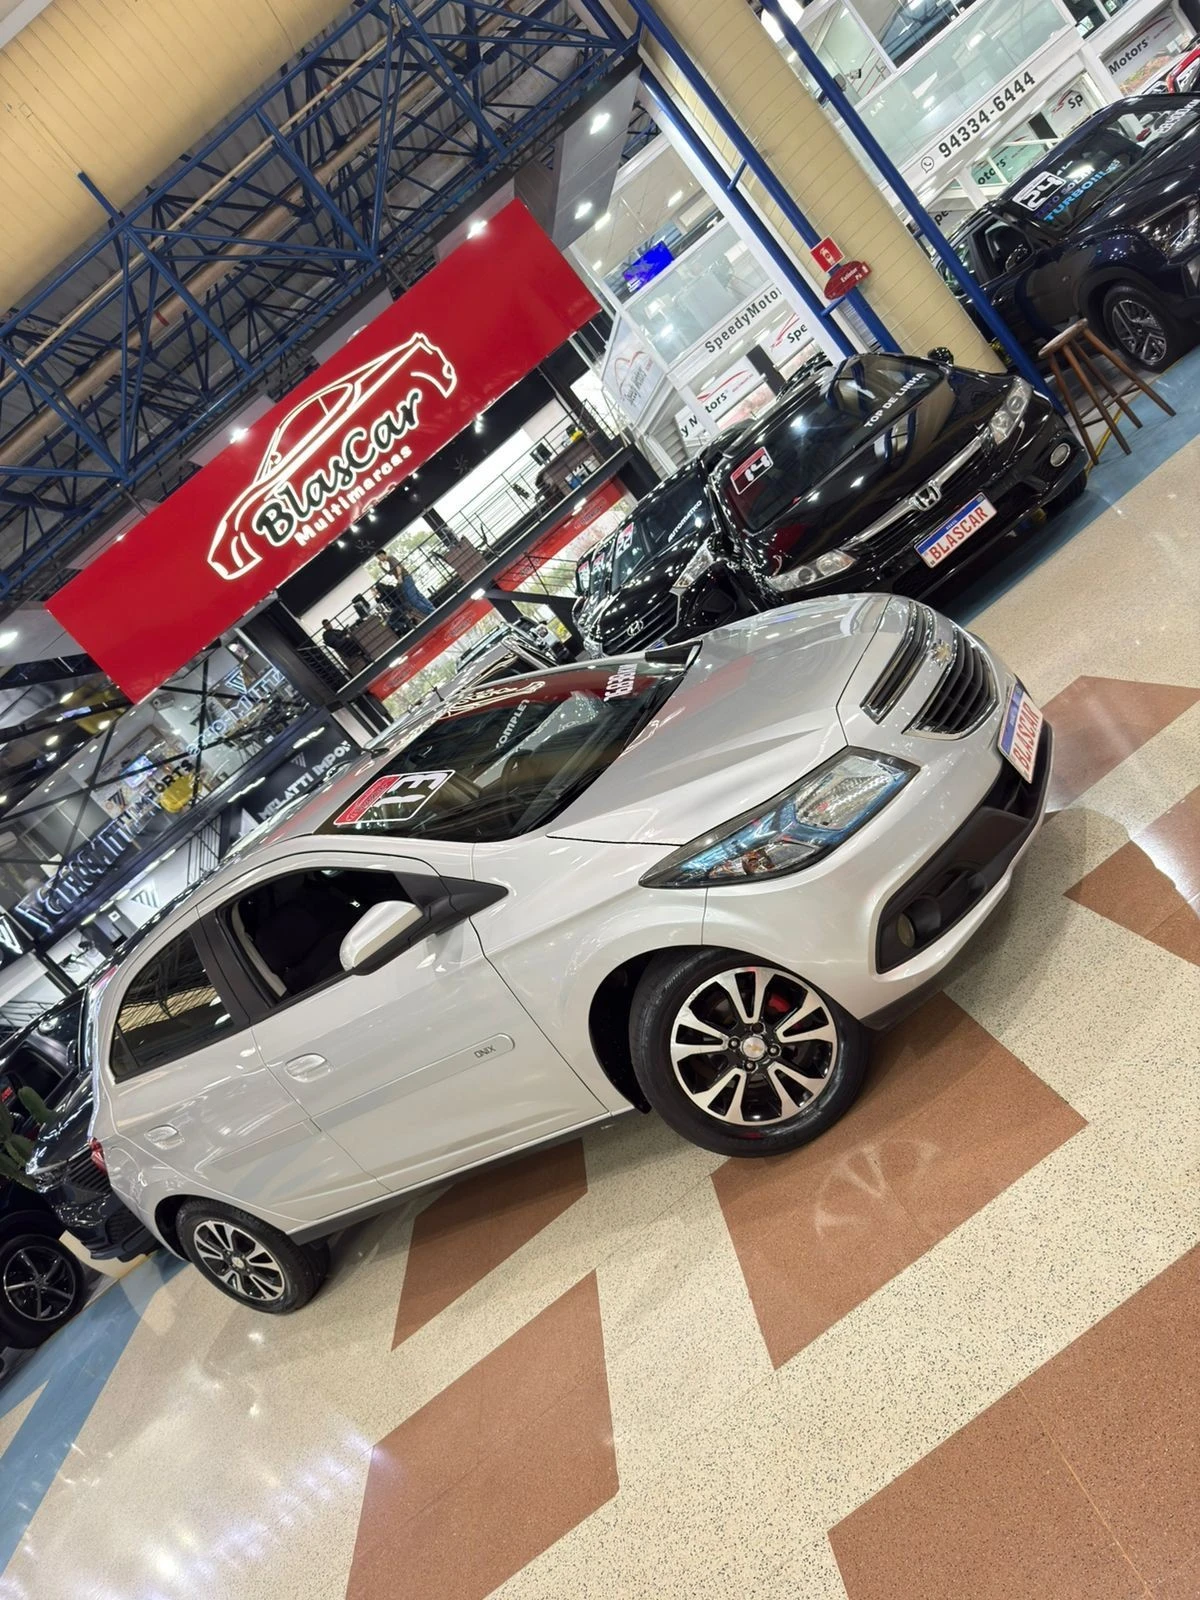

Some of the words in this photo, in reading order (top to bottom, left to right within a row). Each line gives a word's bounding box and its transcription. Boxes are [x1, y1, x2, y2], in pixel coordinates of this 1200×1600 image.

[1107, 39, 1149, 76] Motors
[938, 71, 1036, 158] 94334-6444
[1026, 176, 1065, 209] 24
[863, 409, 884, 428] TOP
[882, 396, 899, 410] DE
[895, 372, 926, 397] LINHA
[252, 388, 423, 547] BlasCar
[293, 445, 412, 547] Multimarcas
[929, 506, 989, 561] BLASCAR
[1013, 702, 1040, 771] BLASCAR
[371, 772, 440, 808] 13
